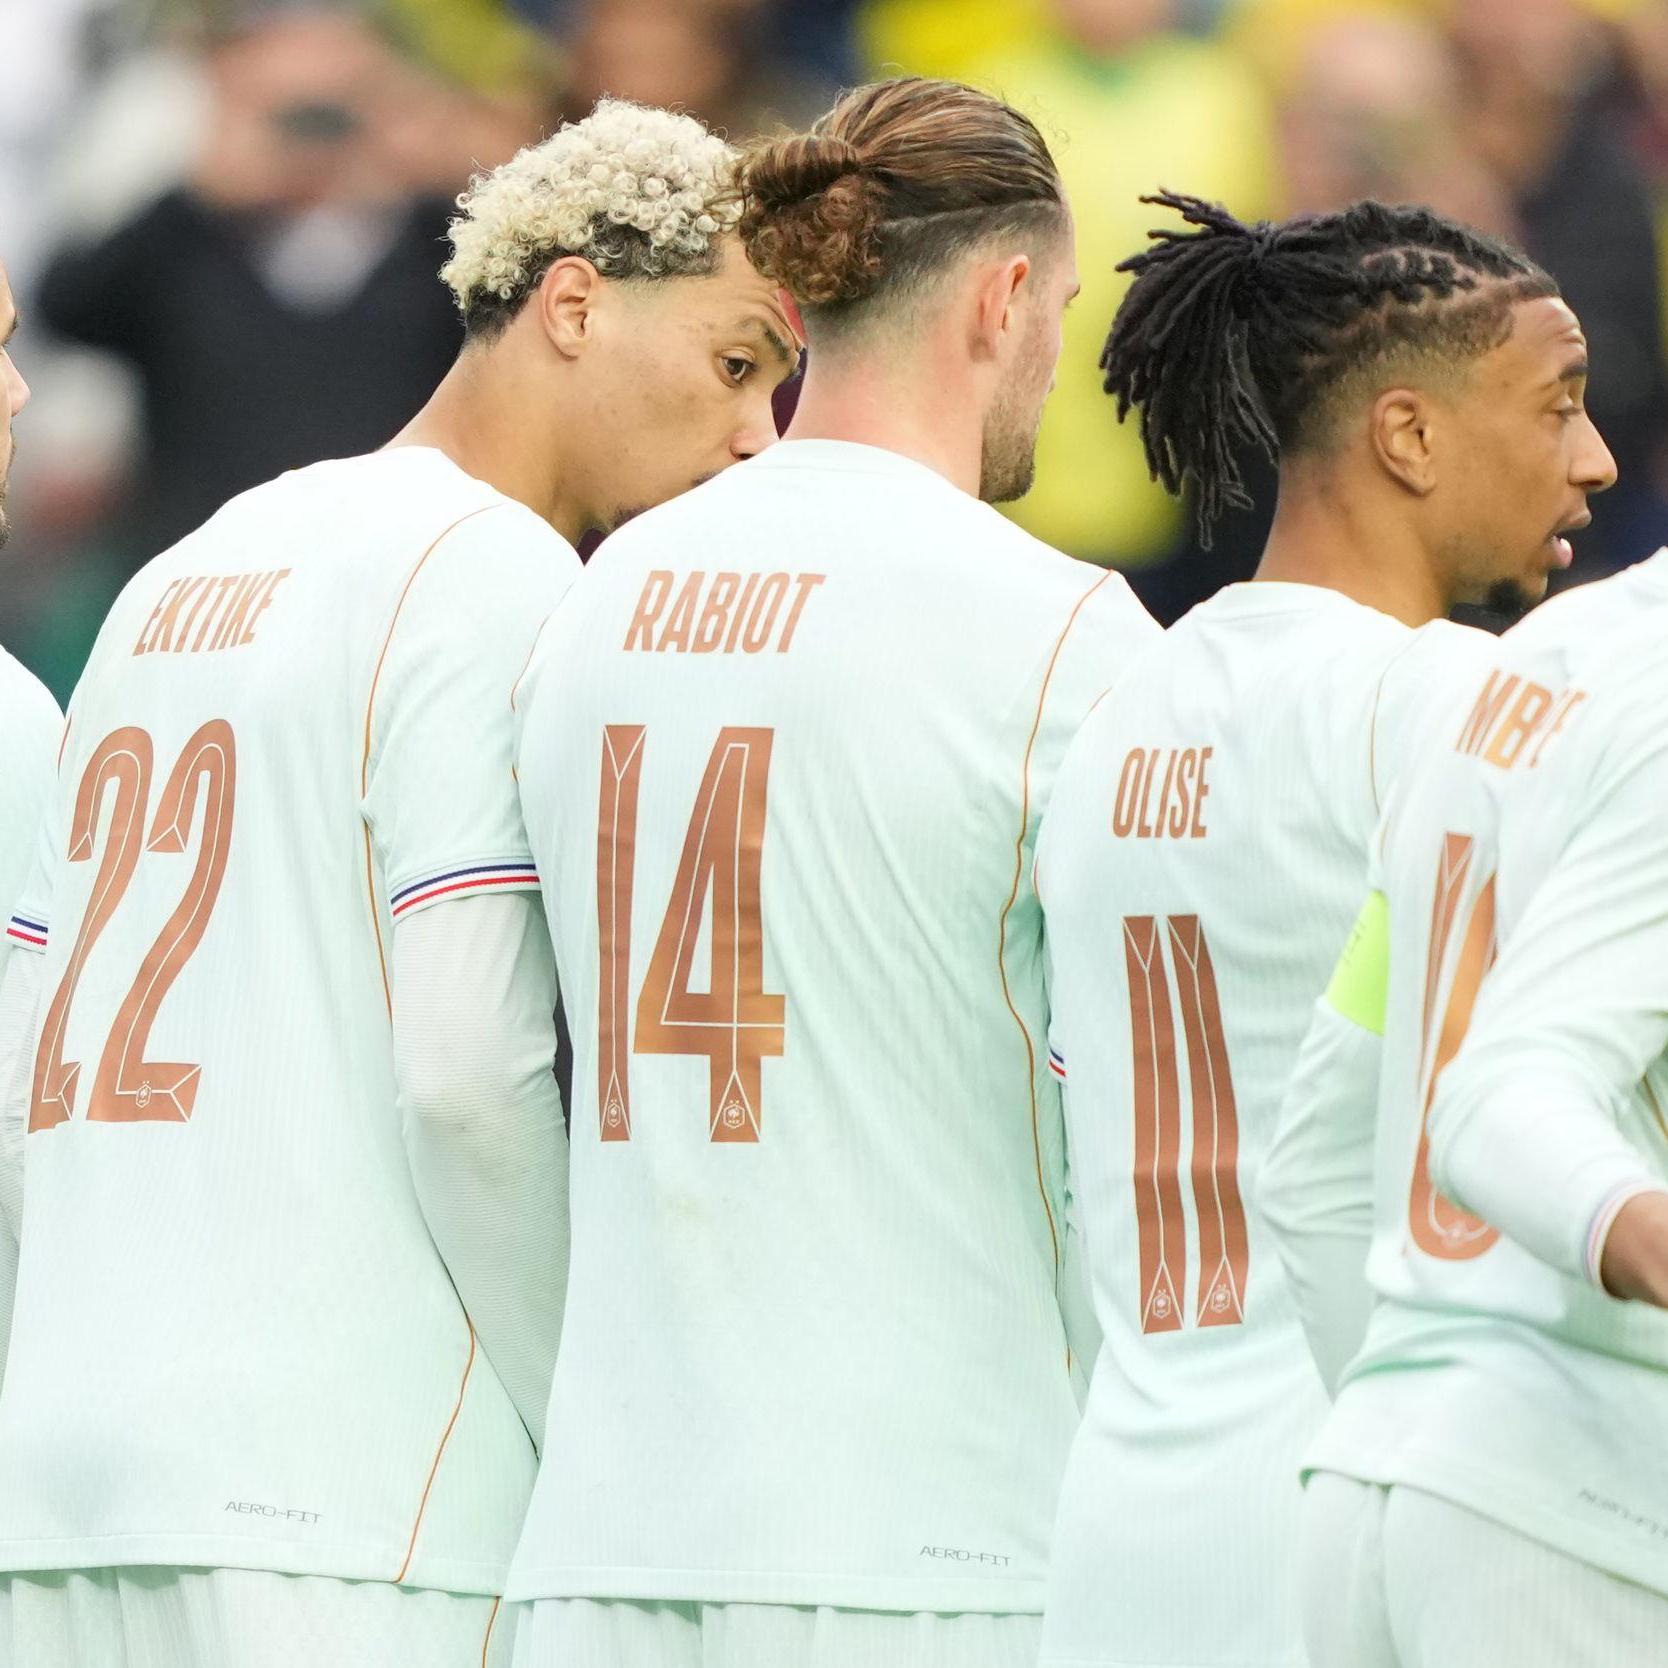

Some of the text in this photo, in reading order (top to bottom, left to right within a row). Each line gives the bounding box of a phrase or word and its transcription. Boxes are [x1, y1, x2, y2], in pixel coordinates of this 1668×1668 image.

[132, 568, 291, 657] EKITIKE
[623, 570, 826, 653] RABIOT
[1112, 747, 1213, 838] OLISE
[28, 719, 236, 1134] 22
[597, 725, 786, 1143] 14
[1122, 914, 1250, 1335] 11
[225, 1501, 323, 1524] AERO-FIT
[920, 1545, 1012, 1567] AERO-FIT
